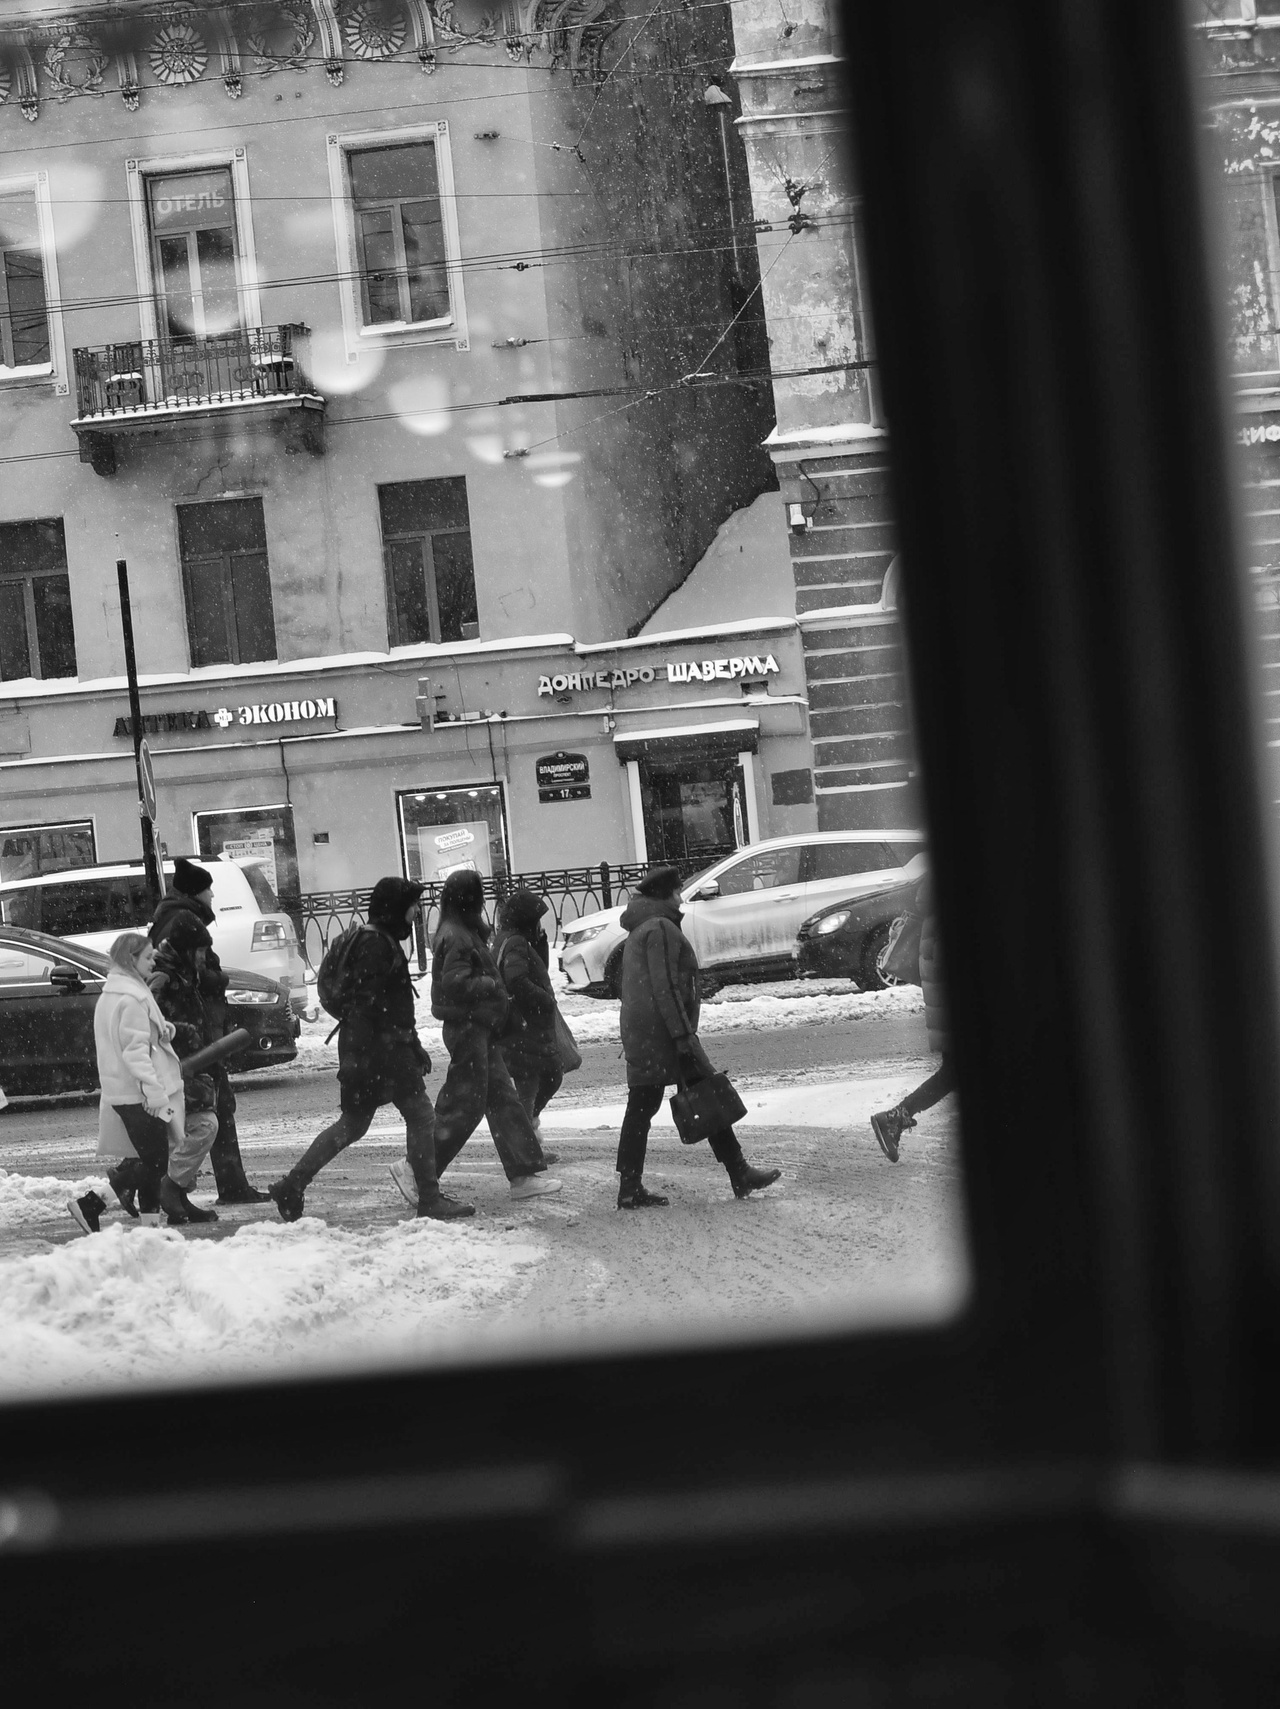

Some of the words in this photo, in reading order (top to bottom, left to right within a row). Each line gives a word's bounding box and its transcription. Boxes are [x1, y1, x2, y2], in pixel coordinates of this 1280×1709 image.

[156, 191, 225, 215] ОТЕЛЬ
[666, 654, 780, 683] ШАВЕРМА
[237, 697, 336, 725] ЭКОНОМ
[560, 789, 569, 798] 17
